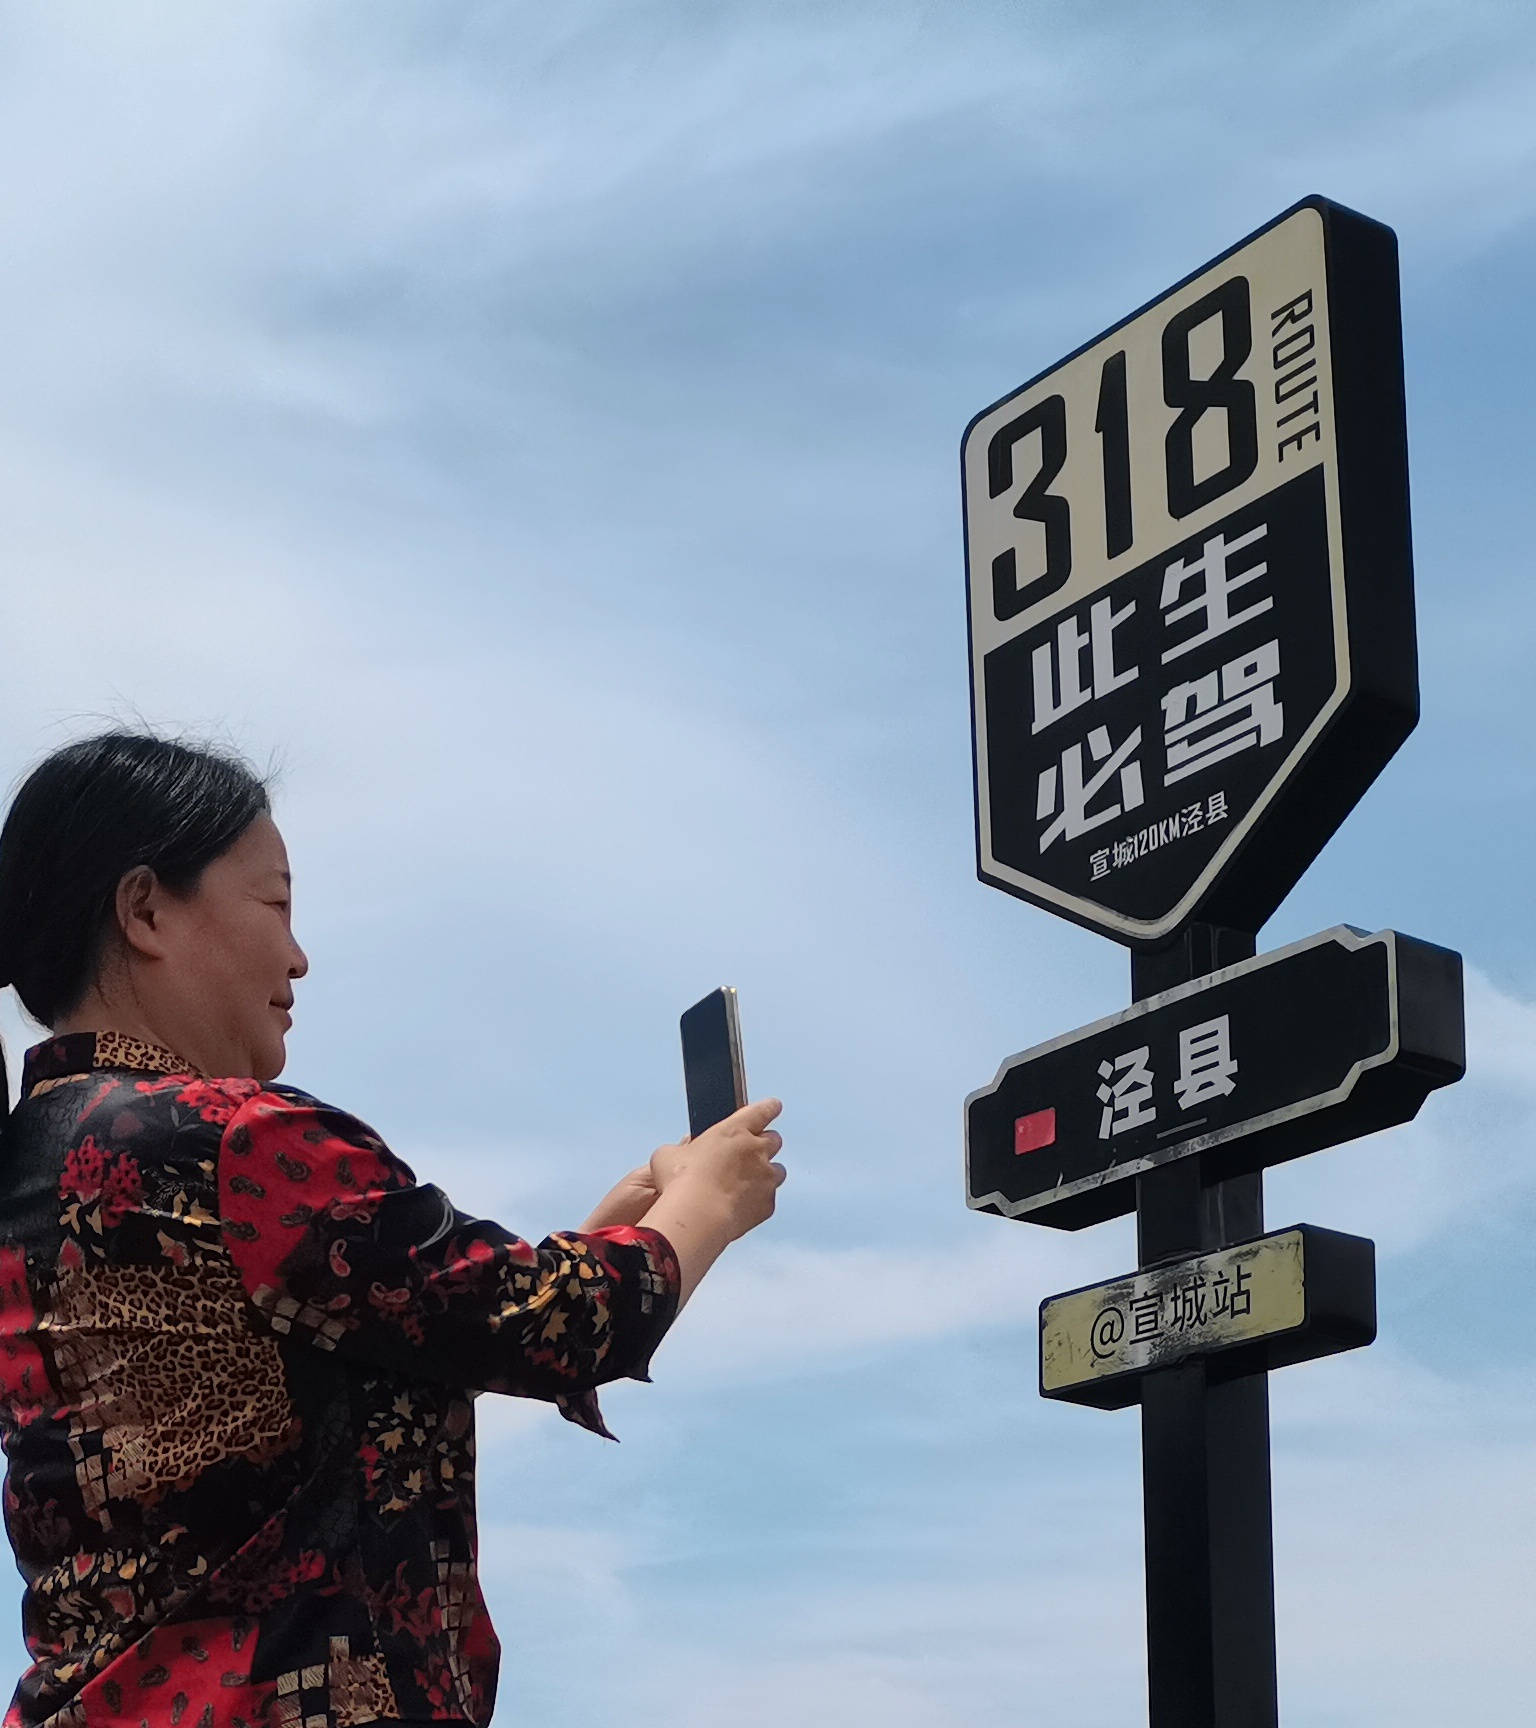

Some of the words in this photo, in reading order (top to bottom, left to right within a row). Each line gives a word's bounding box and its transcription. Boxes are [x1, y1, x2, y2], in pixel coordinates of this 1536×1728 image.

[987, 275, 1259, 622] 318
[1271, 288, 1321, 463] ROUTE
[1031, 523, 1273, 735] 此生
[1036, 639, 1284, 854] 必驾
[1096, 1014, 1238, 1140] 泾县
[1090, 1265, 1252, 1359] @宣城站
